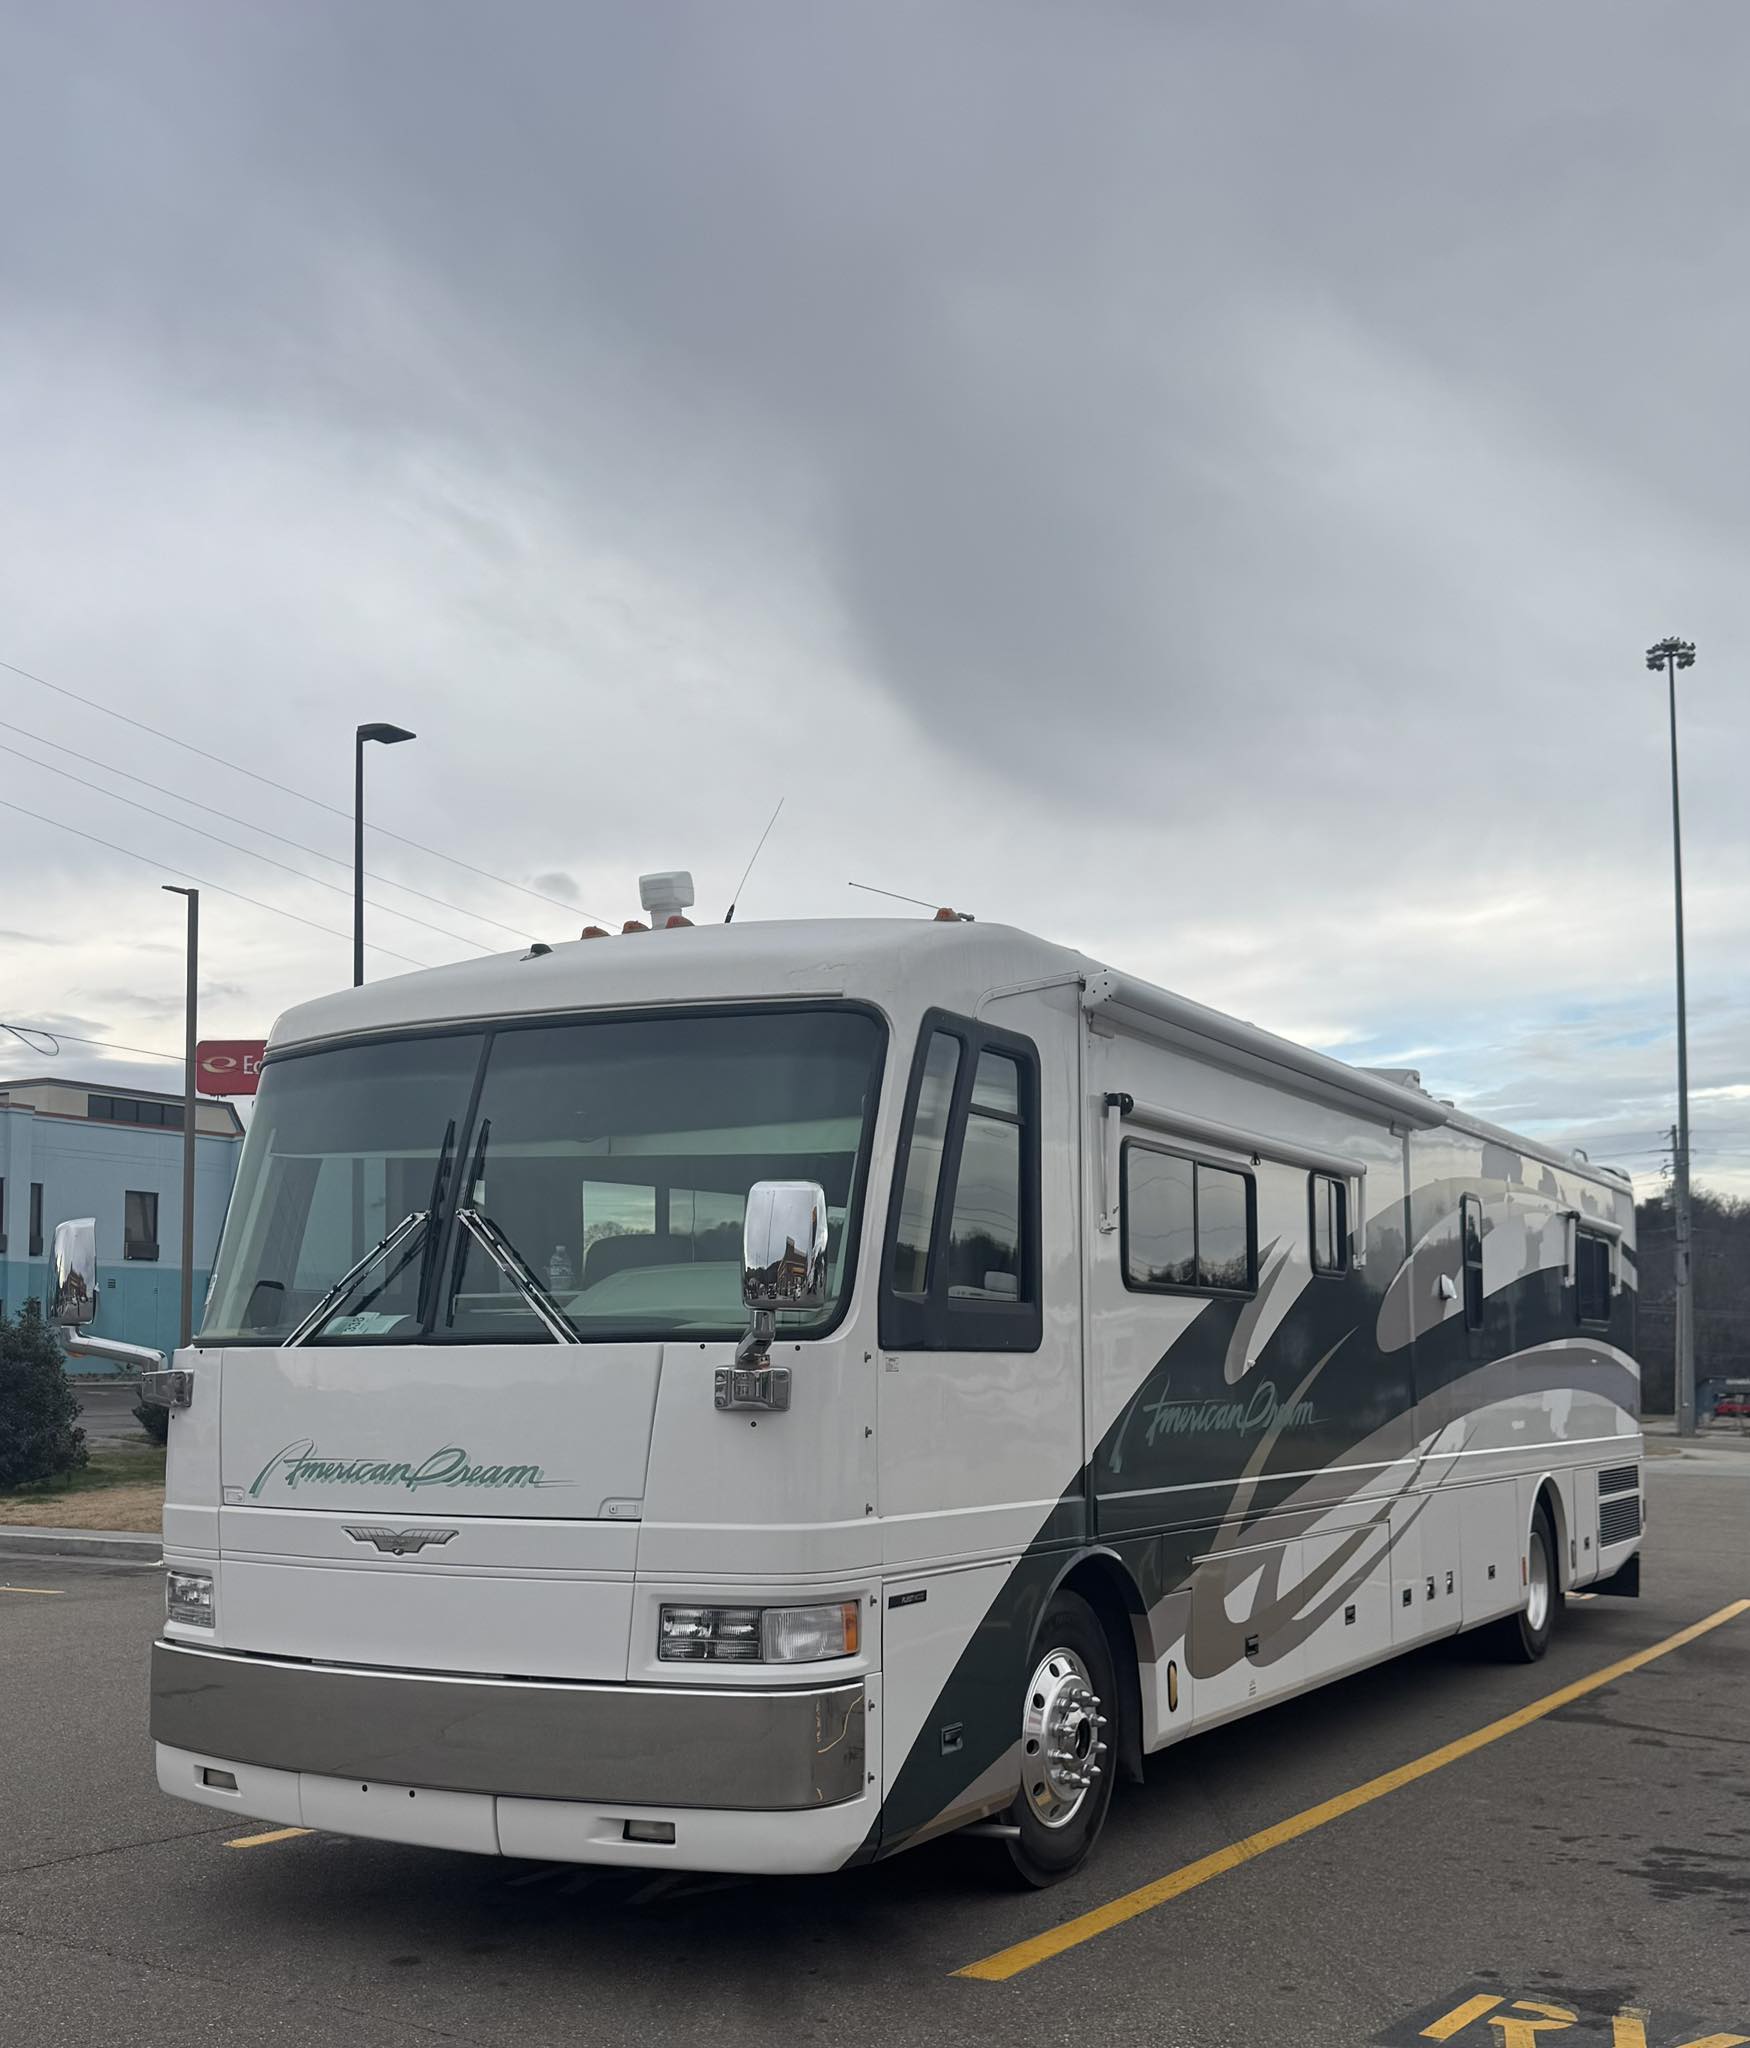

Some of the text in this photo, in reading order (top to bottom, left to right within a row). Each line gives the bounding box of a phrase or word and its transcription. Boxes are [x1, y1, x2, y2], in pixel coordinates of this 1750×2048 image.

[1108, 1371, 1245, 1474] American
[249, 1438, 578, 1498] American Dream
